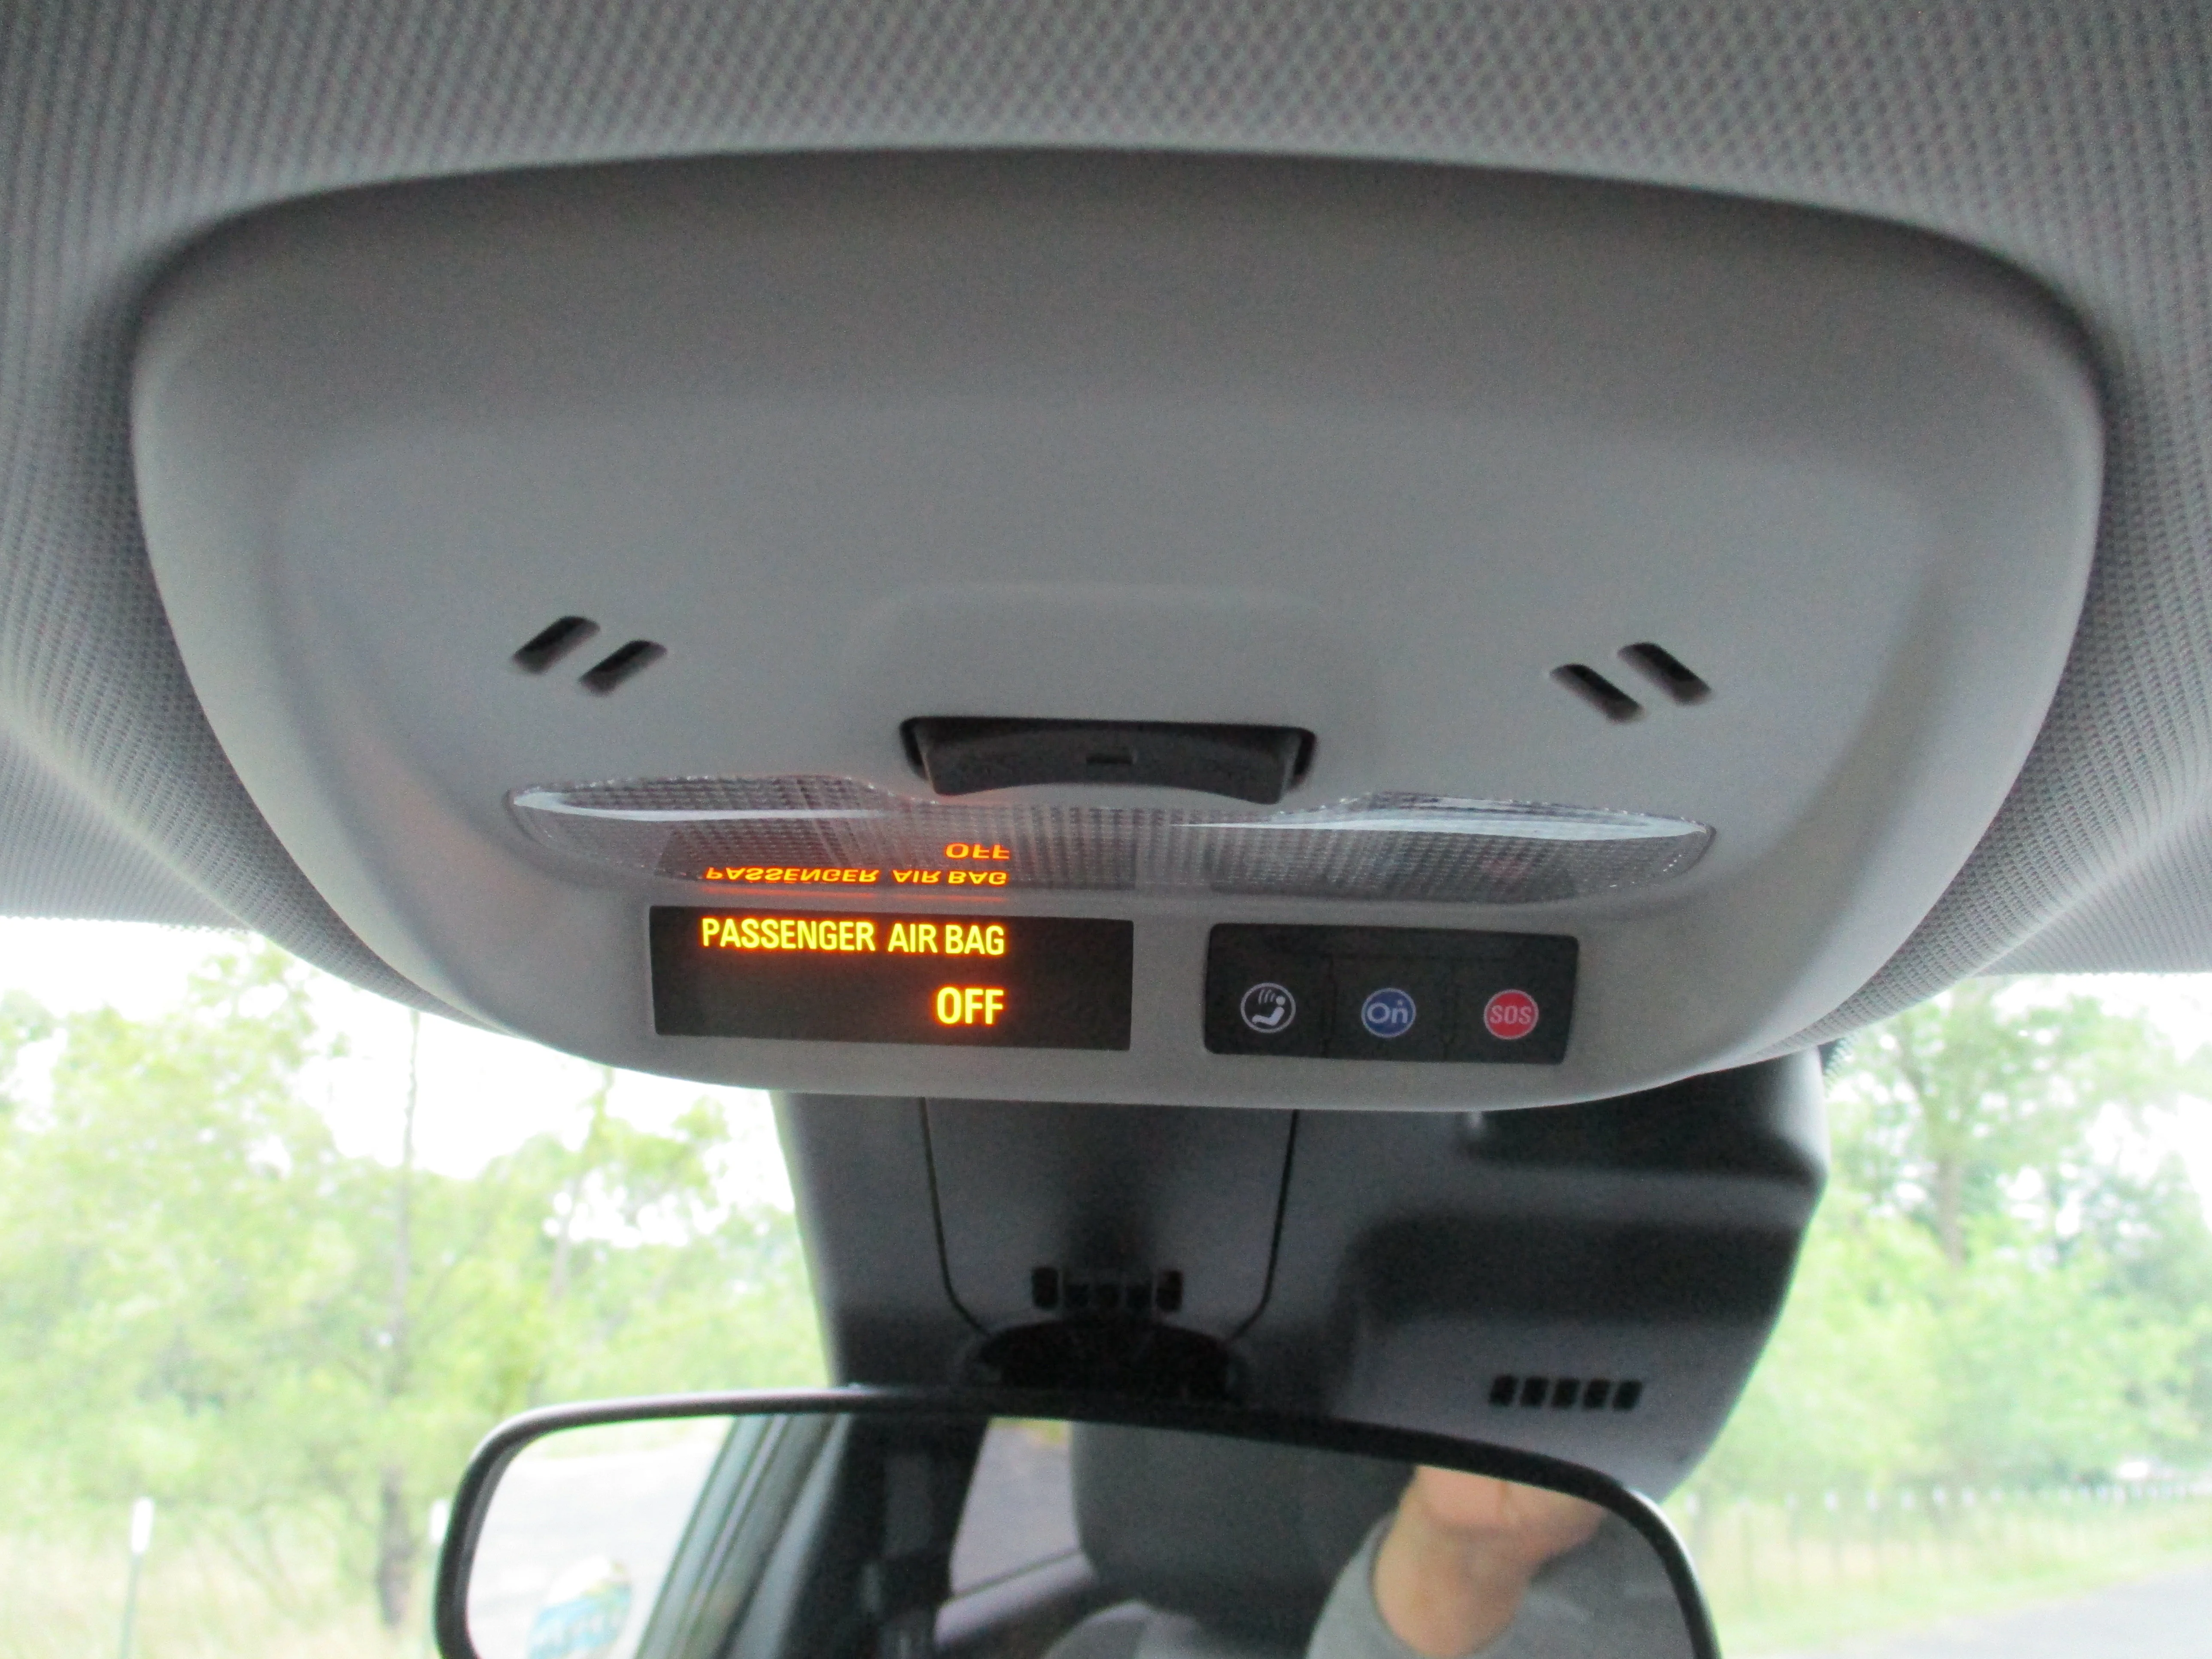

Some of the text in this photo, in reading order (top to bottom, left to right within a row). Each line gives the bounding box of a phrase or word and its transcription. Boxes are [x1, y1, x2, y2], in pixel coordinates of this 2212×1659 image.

[702, 918, 1005, 957] PASSENGER AIR BAG
[936, 986, 1004, 1025] OFF
[1367, 999, 1408, 1024] On
[1489, 1004, 1532, 1025] SOS
